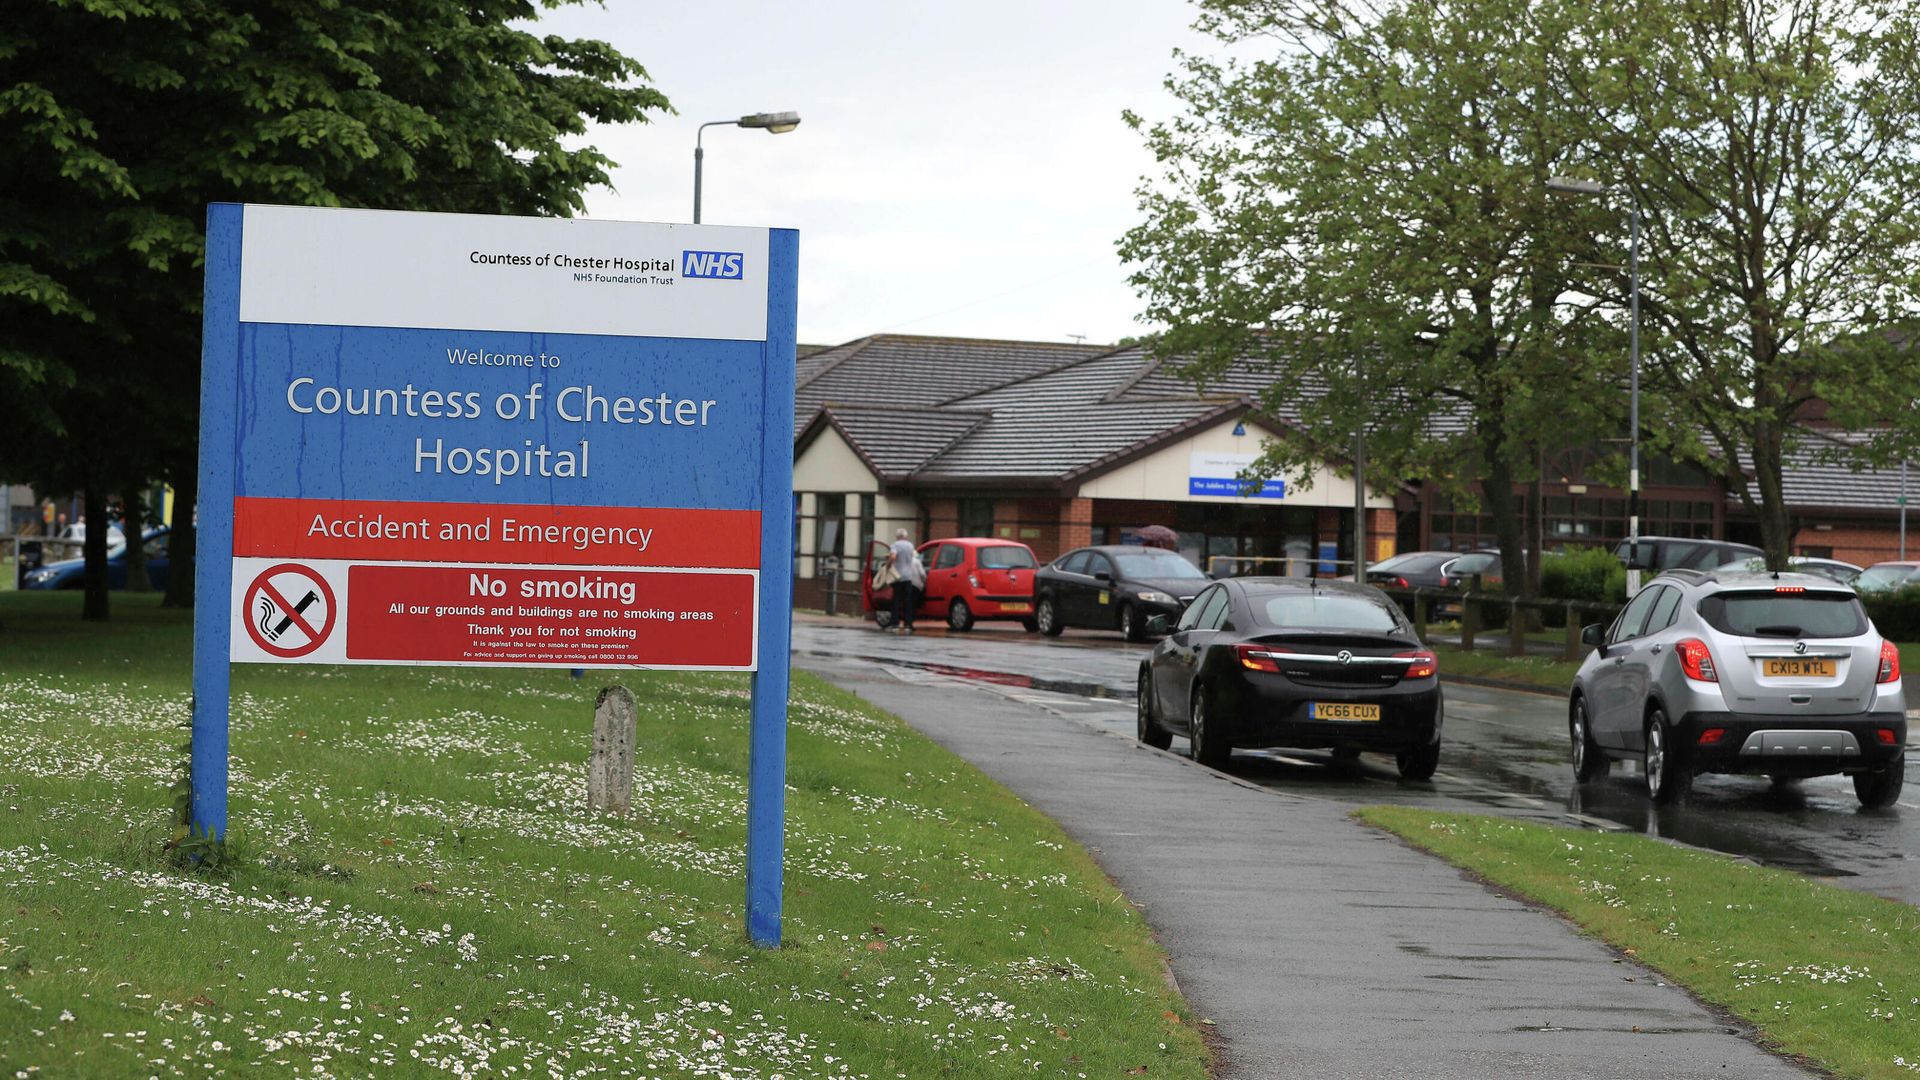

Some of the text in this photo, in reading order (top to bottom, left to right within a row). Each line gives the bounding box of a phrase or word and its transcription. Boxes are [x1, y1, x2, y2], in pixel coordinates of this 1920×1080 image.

[470, 252, 674, 273] Countess of Chester Hospital
[685, 253, 741, 277] NHS
[574, 273, 673, 285] NHS Foundation Trust
[448, 349, 560, 367] Welcome to
[288, 378, 716, 425] Countess of Chester
[416, 438, 588, 484] Hospital
[1194, 481, 1204, 489] The
[308, 515, 652, 551] Accident and Emergency
[470, 574, 635, 604] No smoking
[390, 603, 403, 613] All
[410, 606, 430, 614] our
[436, 605, 485, 616] grounds
[491, 606, 513, 615] and
[519, 606, 572, 619] buildings
[604, 610, 618, 618] no
[624, 609, 674, 621] smoking
[680, 612, 713, 620] areas
[468, 624, 636, 639] Thank you for not smoking
[1771, 661, 1828, 674] CX13 WTL
[1318, 705, 1378, 718] YC66 CUX
